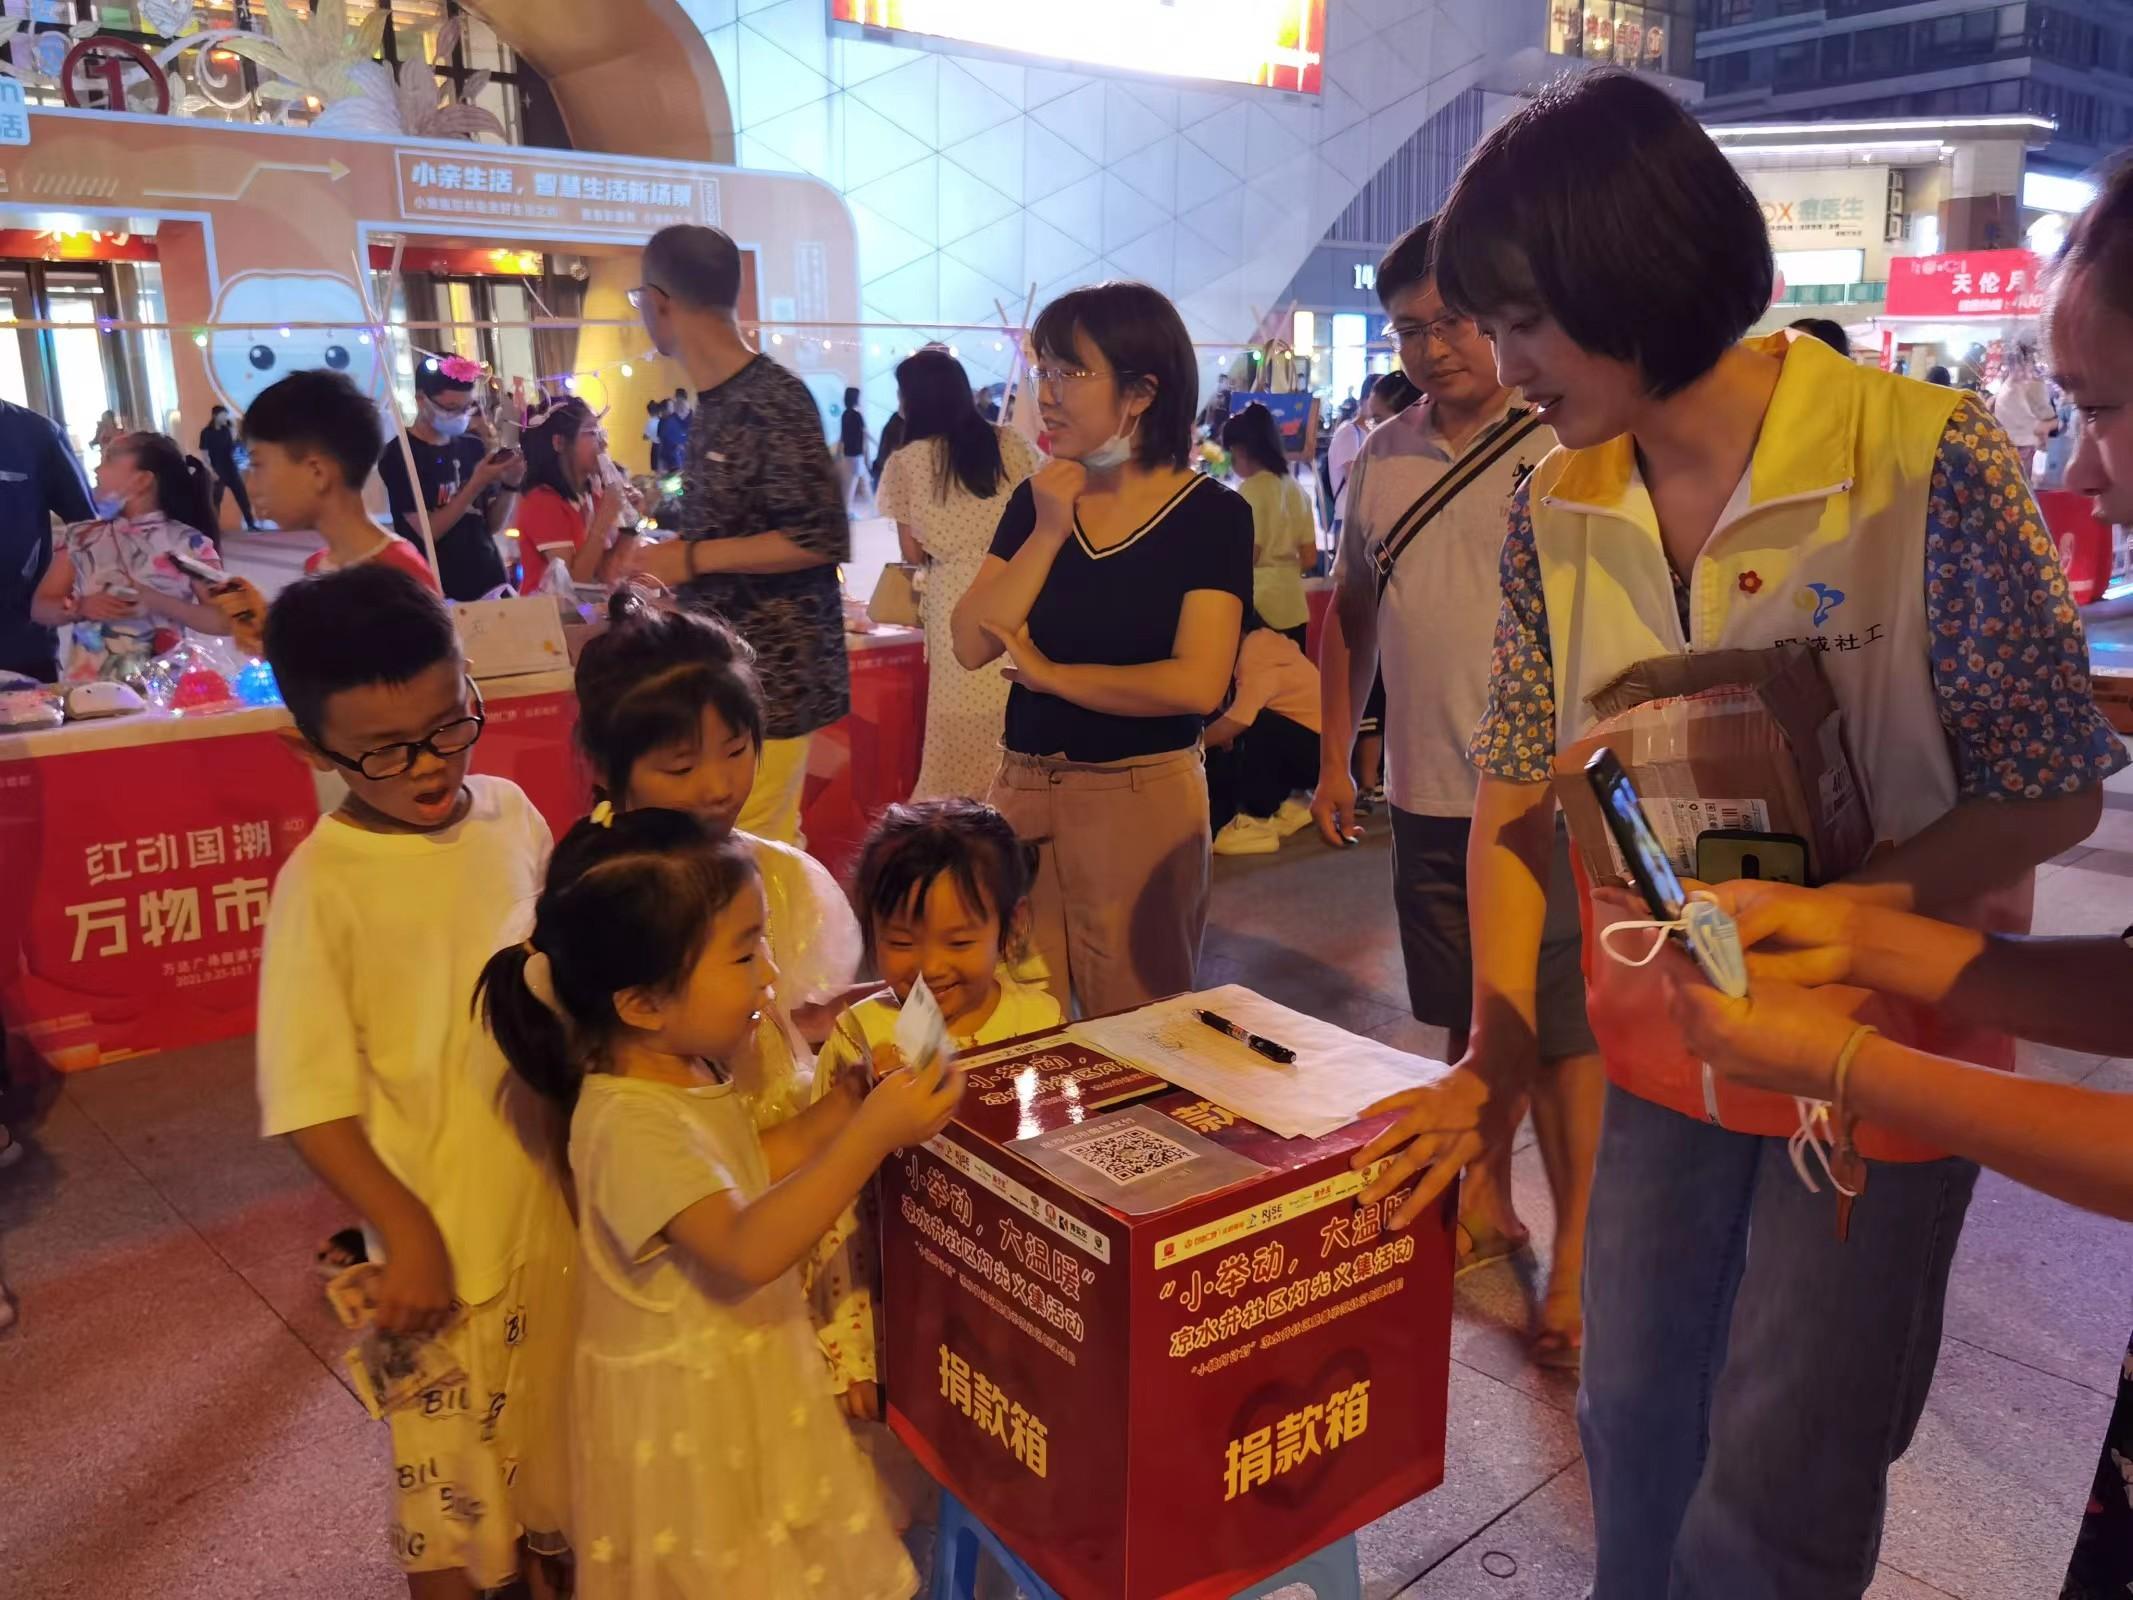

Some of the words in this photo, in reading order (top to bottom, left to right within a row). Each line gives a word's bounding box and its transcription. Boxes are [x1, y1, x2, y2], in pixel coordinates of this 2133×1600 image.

[85, 820, 272, 886] 红动国潮
[1168, 1235, 1415, 1358] 凉水井社区灯光义集活动
[938, 1343, 1048, 1479] 捐款箱
[1224, 1380, 1371, 1502] 捐款箱
